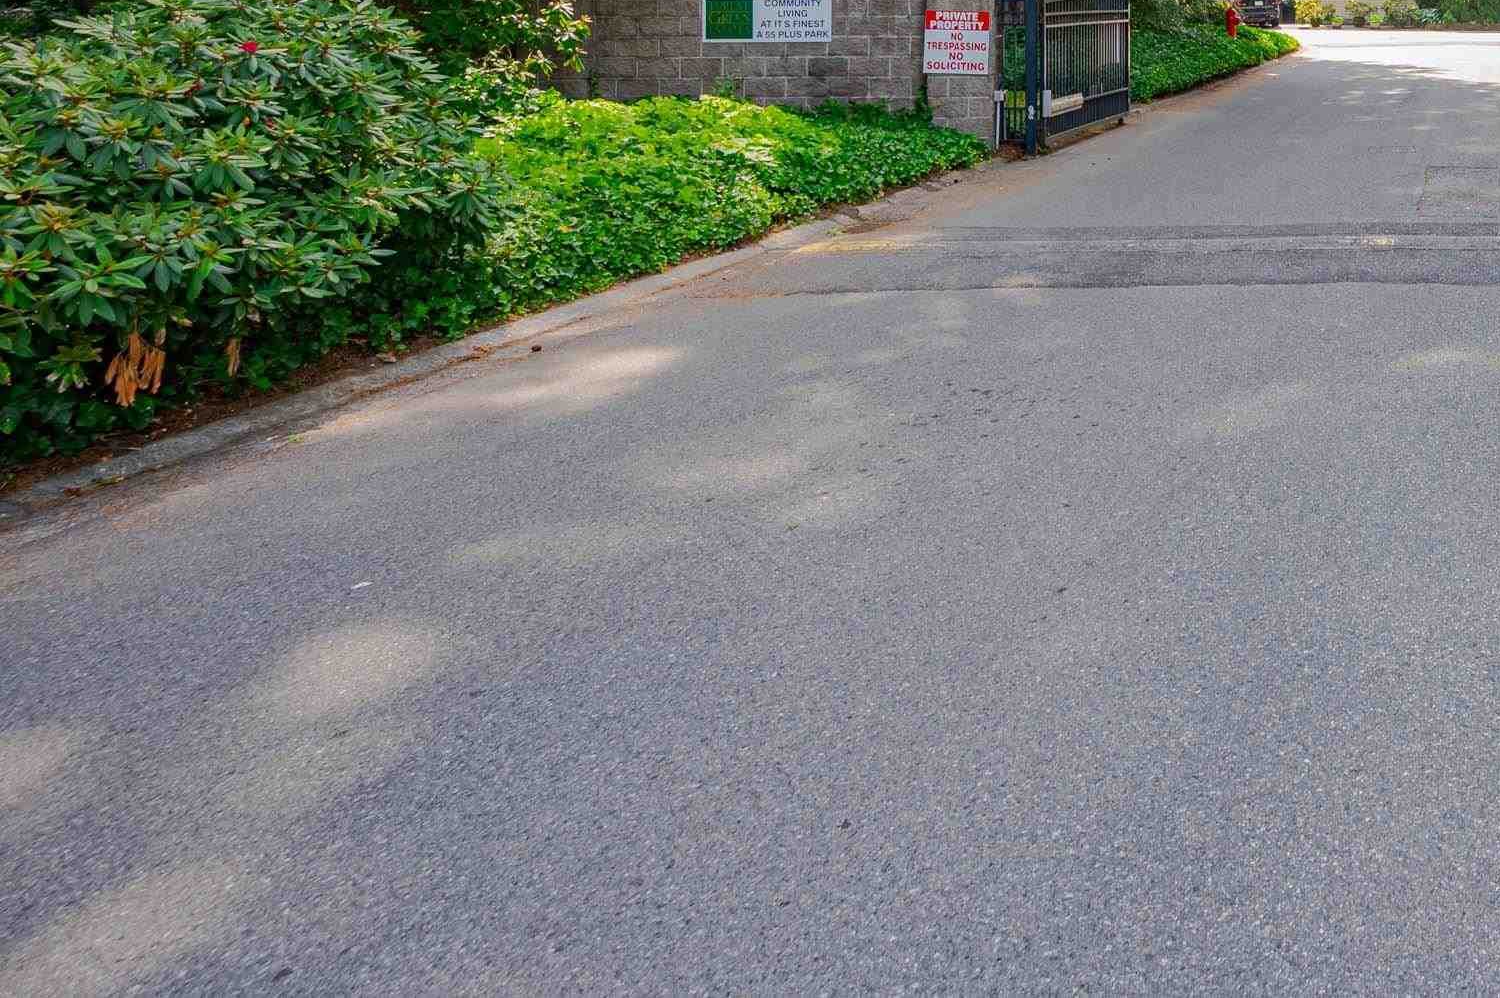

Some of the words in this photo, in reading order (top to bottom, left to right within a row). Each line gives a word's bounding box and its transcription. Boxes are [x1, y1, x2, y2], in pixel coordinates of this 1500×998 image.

[764, 0, 821, 7] COMMUNITY
[777, 9, 808, 17] LIVING
[935, 11, 979, 21] PRIVATE
[760, 19, 771, 28] AT
[793, 19, 824, 28] FINEST
[930, 20, 984, 30] PROPERTY
[778, 31, 802, 39] PLUS
[804, 31, 829, 39] PARK
[951, 32, 964, 41] NO
[927, 42, 987, 51] TRESPASSING
[949, 52, 964, 60] NO
[927, 61, 985, 71] SOLICITING
